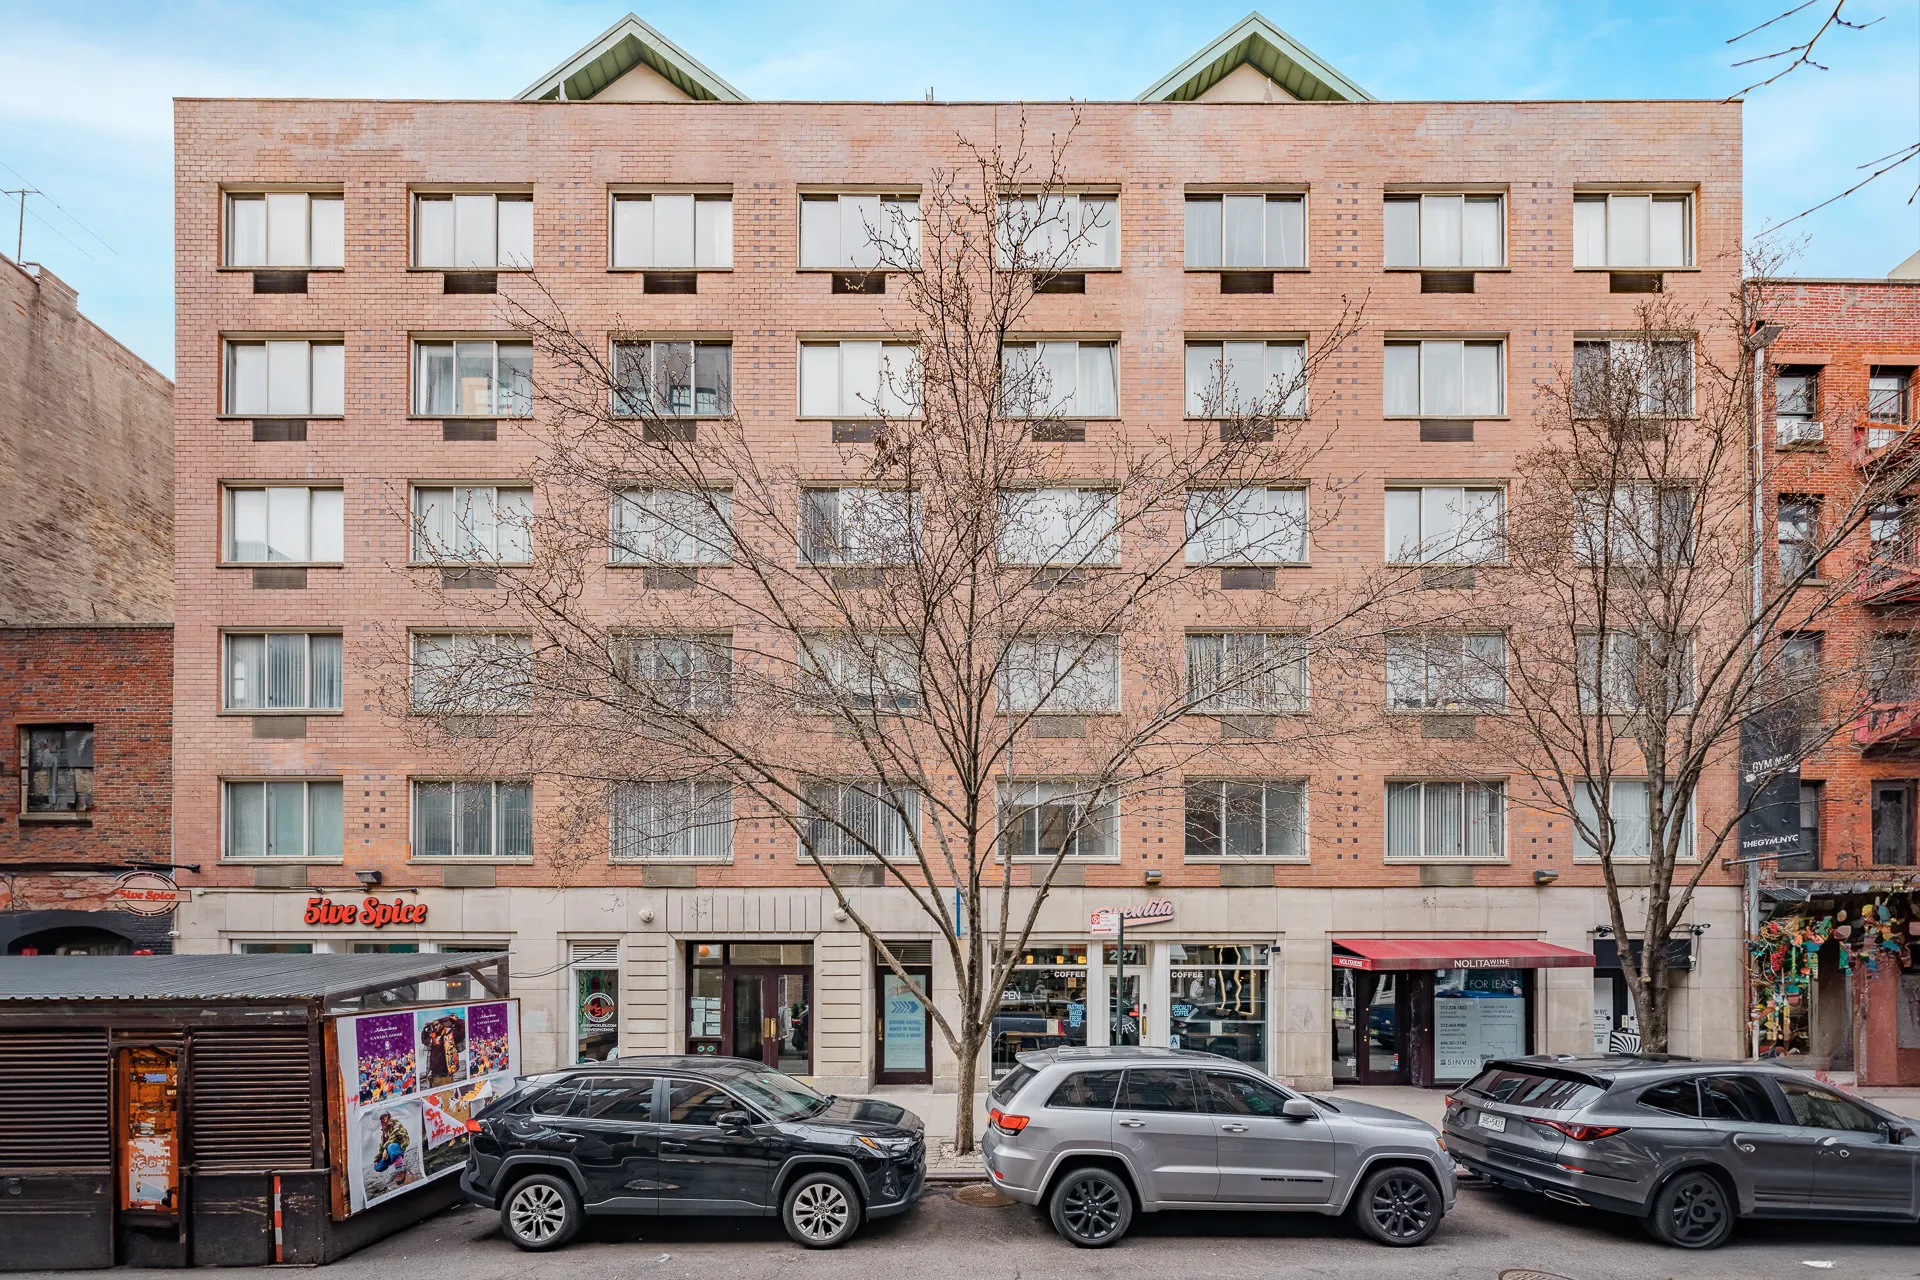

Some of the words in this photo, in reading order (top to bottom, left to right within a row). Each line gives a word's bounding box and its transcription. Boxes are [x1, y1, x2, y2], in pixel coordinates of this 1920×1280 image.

[1752, 758, 1773, 773] GYM
[1742, 834, 1799, 849] THEGYM.NYC
[145, 890, 176, 901] Spice
[303, 897, 357, 924] 5ive
[358, 896, 427, 929] Spice
[1454, 959, 1490, 968] NOLITA
[1171, 971, 1203, 979] COFFEE
[1469, 979, 1489, 989] FOR
[1000, 990, 1021, 1000] PEN
